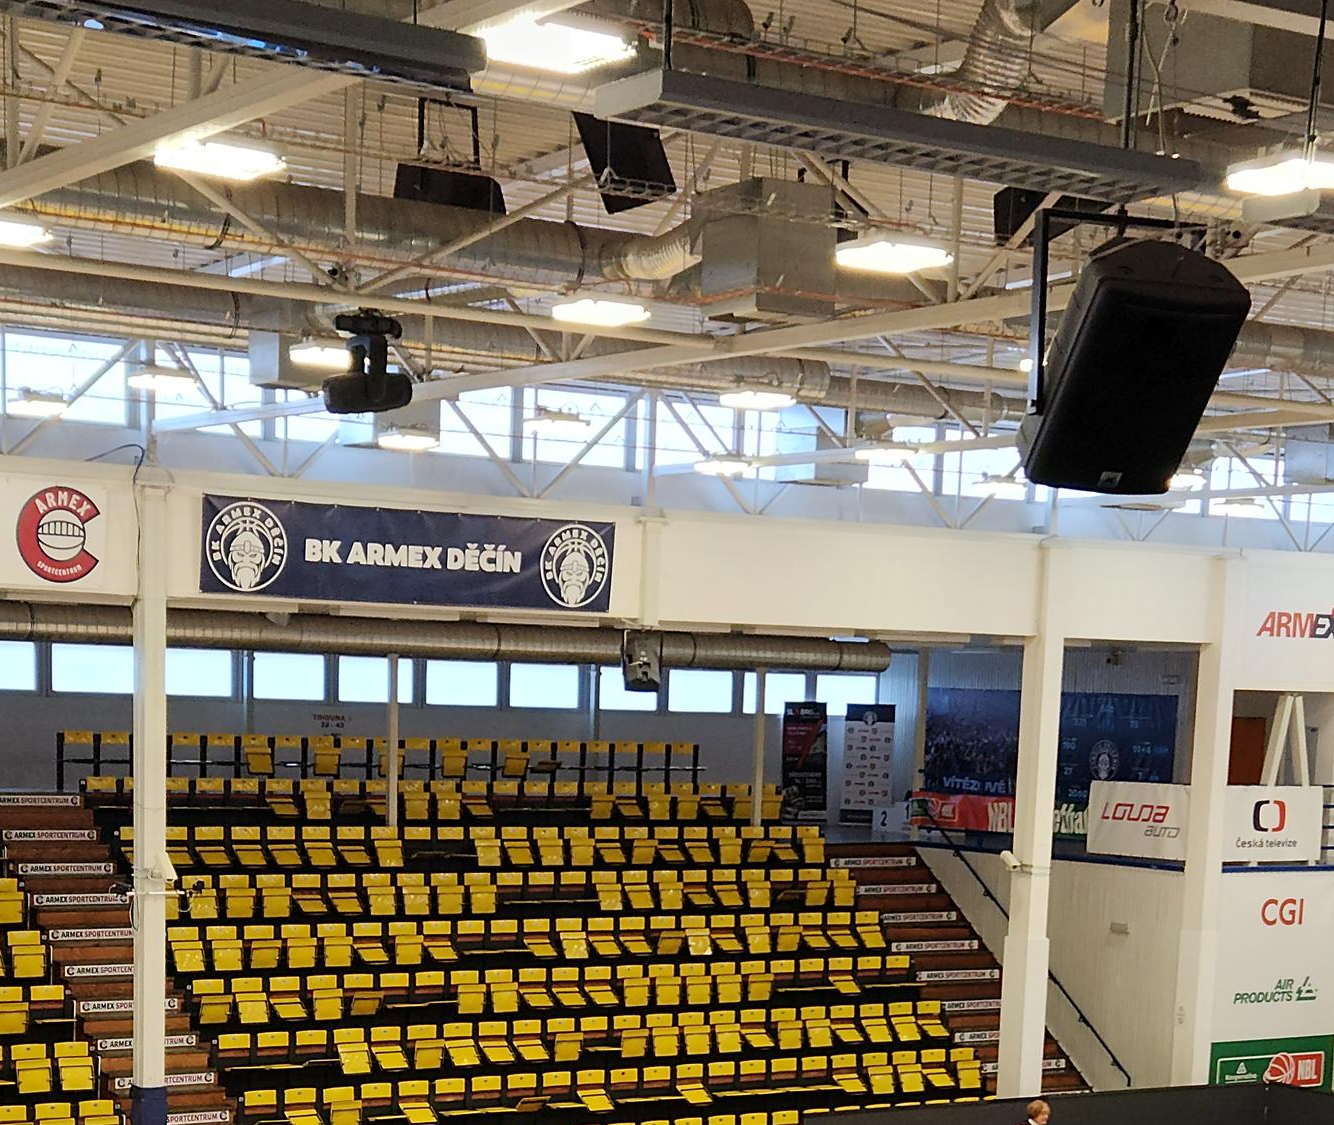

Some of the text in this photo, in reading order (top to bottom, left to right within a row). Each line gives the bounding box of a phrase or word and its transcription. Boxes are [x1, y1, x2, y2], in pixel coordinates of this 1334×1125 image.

[33, 489, 91, 518] ARMEX
[215, 506, 262, 535] ARMEX
[305, 538, 522, 574] BK ARMEX DĚČÍN
[880, 810, 887, 826] 2
[1101, 802, 1170, 824] LOUDA
[1235, 837, 1298, 848] Česká televize
[30, 864, 52, 872] ARMEX
[46, 896, 68, 904] ARMEX
[1260, 898, 1304, 925] CGI
[77, 966, 99, 974] ARMEX
[1274, 979, 1294, 990] AIR
[1234, 991, 1293, 1004] PRODUCTS
[92, 1002, 114, 1010] ARMEX
